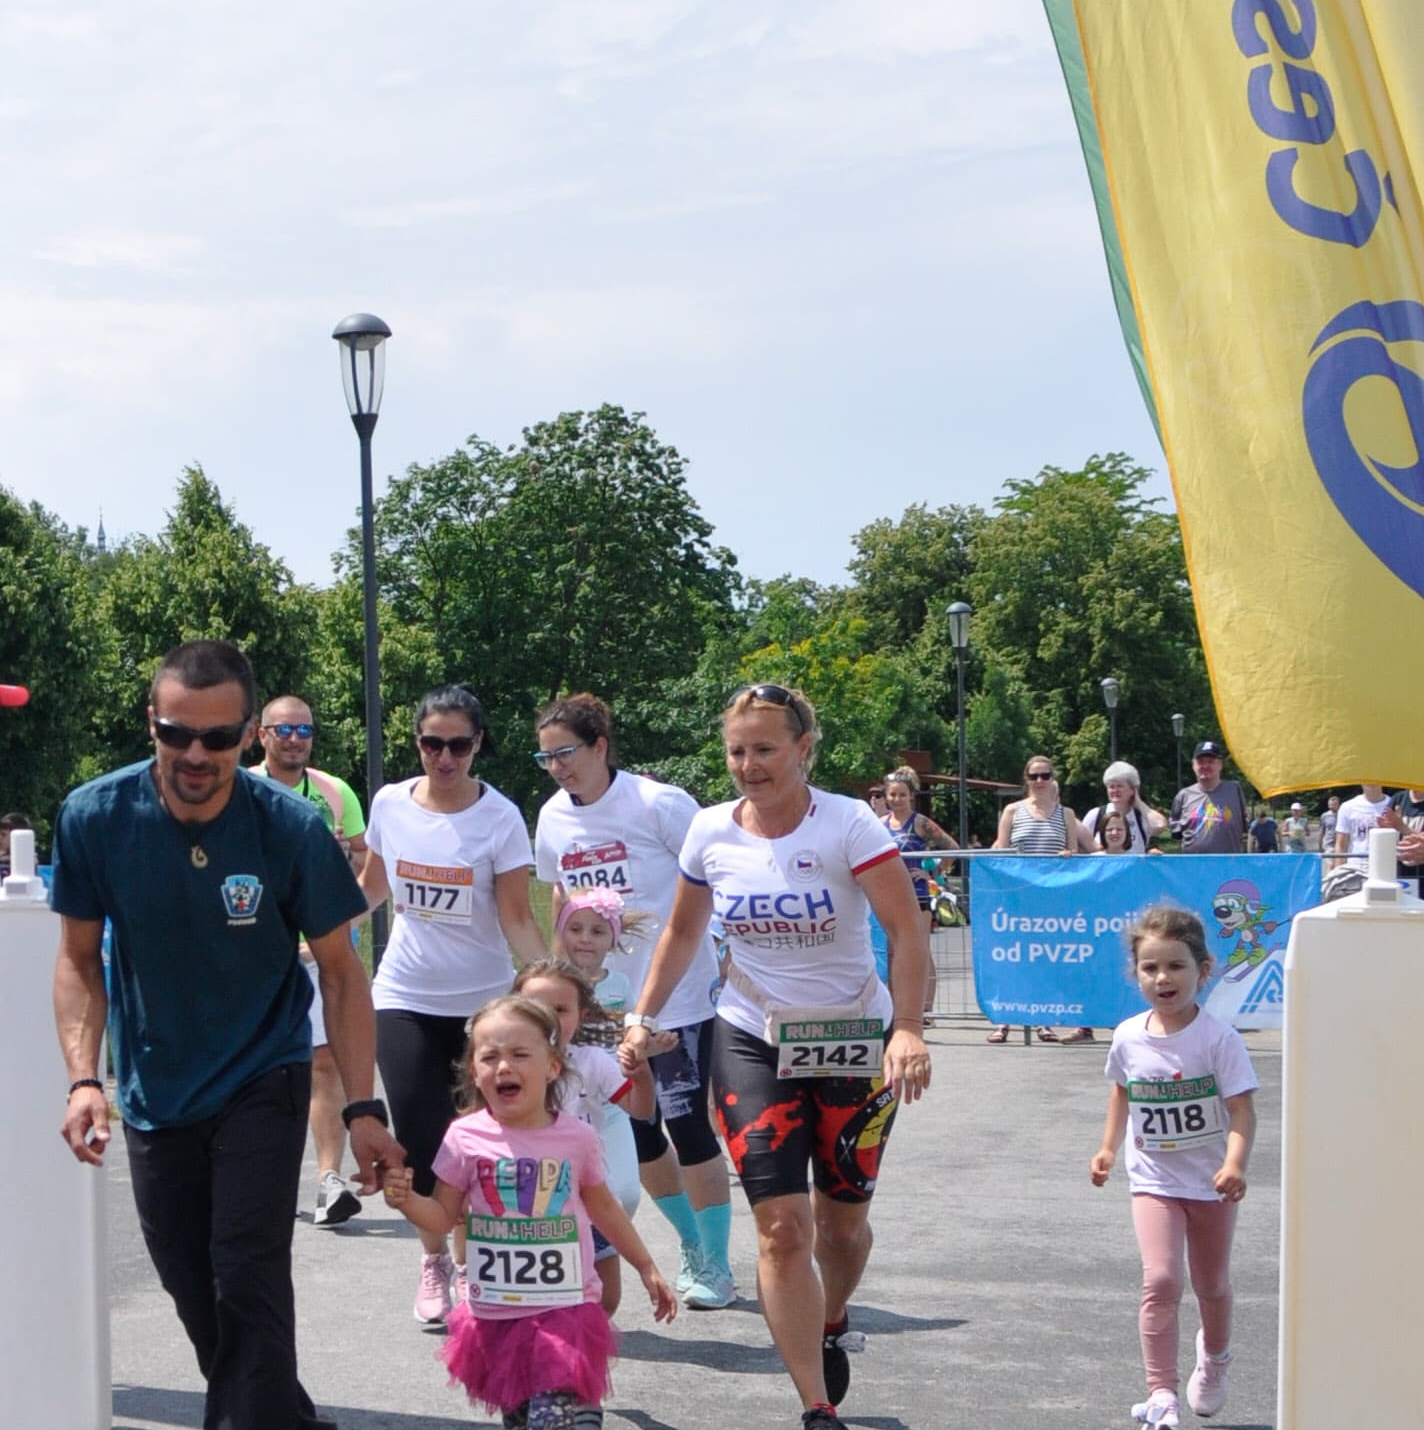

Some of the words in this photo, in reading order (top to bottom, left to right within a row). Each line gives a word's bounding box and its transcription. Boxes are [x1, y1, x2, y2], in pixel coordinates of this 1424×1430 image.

[567, 866, 627, 889] 3084
[404, 882, 460, 910] 1177
[721, 917, 837, 937] EPUBLIC
[991, 907, 1088, 934] Úrazové
[991, 942, 1022, 963] od
[1029, 943, 1094, 964] PVZP
[991, 1001, 1084, 1016] www.pvzp.cz
[791, 1044, 869, 1067] 2142
[1140, 1104, 1207, 1135] 2118
[477, 1157, 572, 1198] PEPPA
[471, 1219, 509, 1239] RUN
[521, 1219, 575, 1241] HELP
[478, 1248, 565, 1285] 2128
